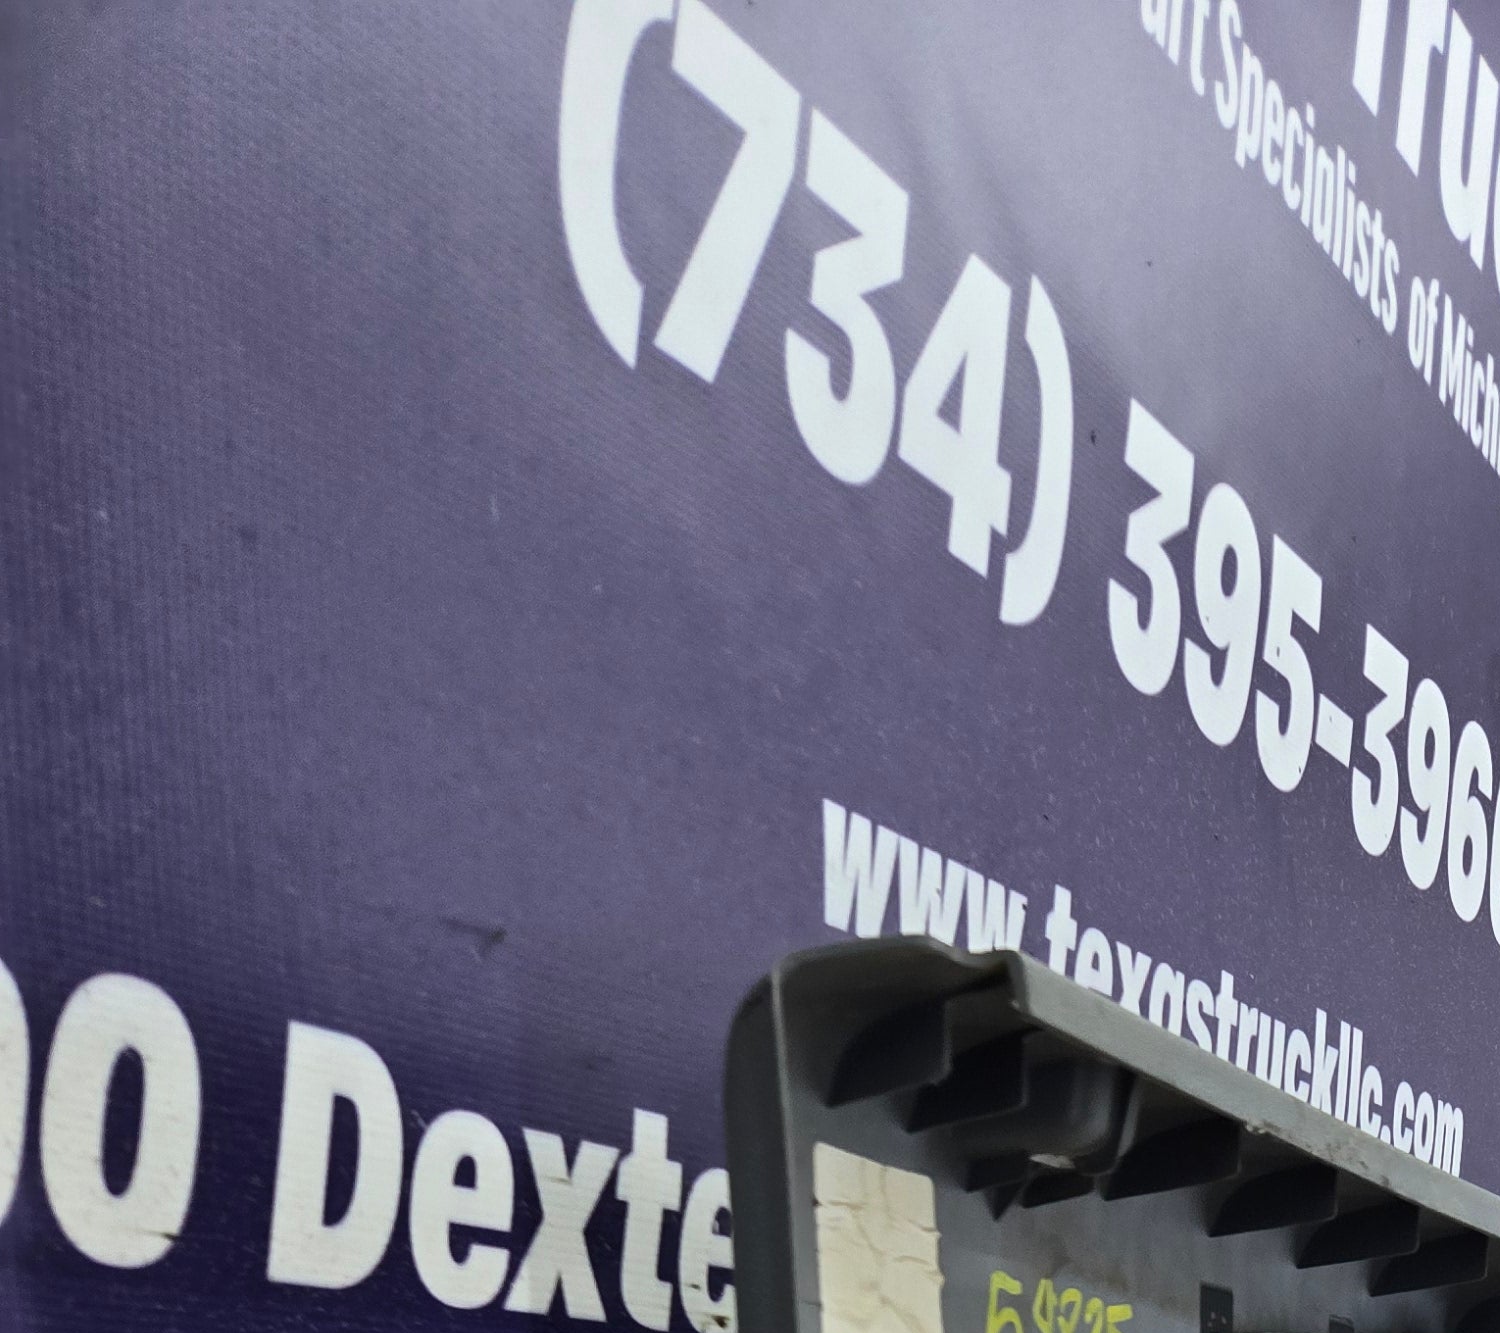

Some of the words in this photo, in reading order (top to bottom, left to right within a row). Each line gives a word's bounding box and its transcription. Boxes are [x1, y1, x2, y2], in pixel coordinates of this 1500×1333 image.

[558, 0, 1073, 625] (734)
[1214, 0, 1400, 335] Specialists
[1407, 277, 1440, 384] of
[0, 957, 202, 1270] 0
[822, 798, 1463, 1178] wwwtexastruckllc.com
